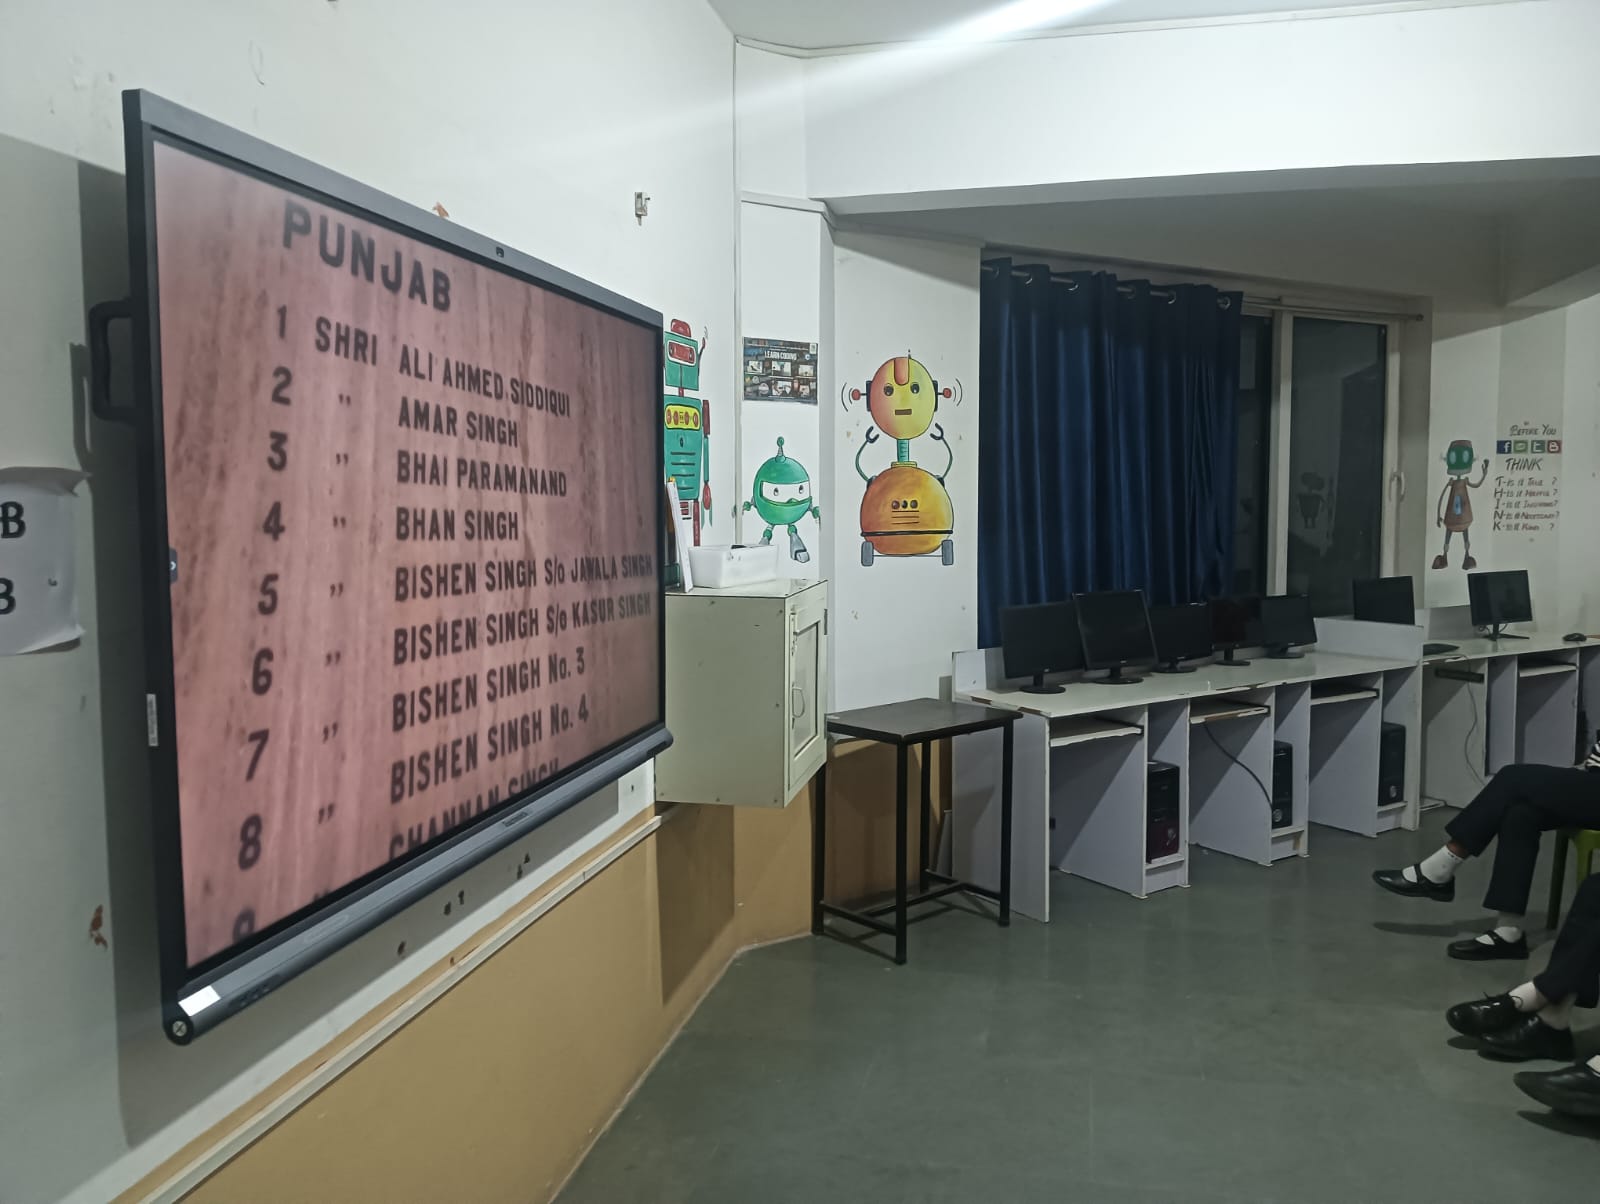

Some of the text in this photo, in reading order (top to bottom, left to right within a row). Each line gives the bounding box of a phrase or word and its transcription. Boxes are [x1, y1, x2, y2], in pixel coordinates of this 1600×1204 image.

[283, 200, 451, 312] PUNJAB
[271, 366, 292, 406] 2
[398, 396, 458, 437] AMAR
[466, 411, 518, 448] SINGH
[277, 304, 288, 339] 1
[315, 316, 378, 366] SHRI
[399, 343, 433, 382] ALI
[510, 378, 571, 419] SIDDIQUI
[268, 431, 288, 471] 3
[397, 450, 448, 488] BHAI
[457, 458, 567, 497] PARAMANAND
[1505, 458, 1543, 471] THINK
[263, 502, 285, 541] 4
[396, 506, 455, 541] BHAN
[464, 510, 519, 541] SINGH
[258, 573, 279, 616] 5
[395, 562, 477, 603] BISHEN
[485, 559, 537, 592] SINGH
[571, 555, 618, 583] JAWALA
[621, 554, 652, 578] SINGH
[252, 647, 274, 696] 6
[394, 619, 477, 666] BISHEN
[486, 608, 539, 646] SINGH
[572, 598, 615, 628] KASUR
[618, 592, 650, 619] SINGH
[245, 728, 270, 782] 7
[392, 675, 478, 732] BISHEN
[487, 657, 541, 702] SINGH
[548, 653, 571, 684] No.
[576, 646, 585, 675] 3
[238, 813, 262, 870] 8
[390, 729, 478, 805] BISHEN
[488, 709, 542, 761] SINGH
[550, 702, 573, 736] No.
[578, 693, 589, 723] 4
